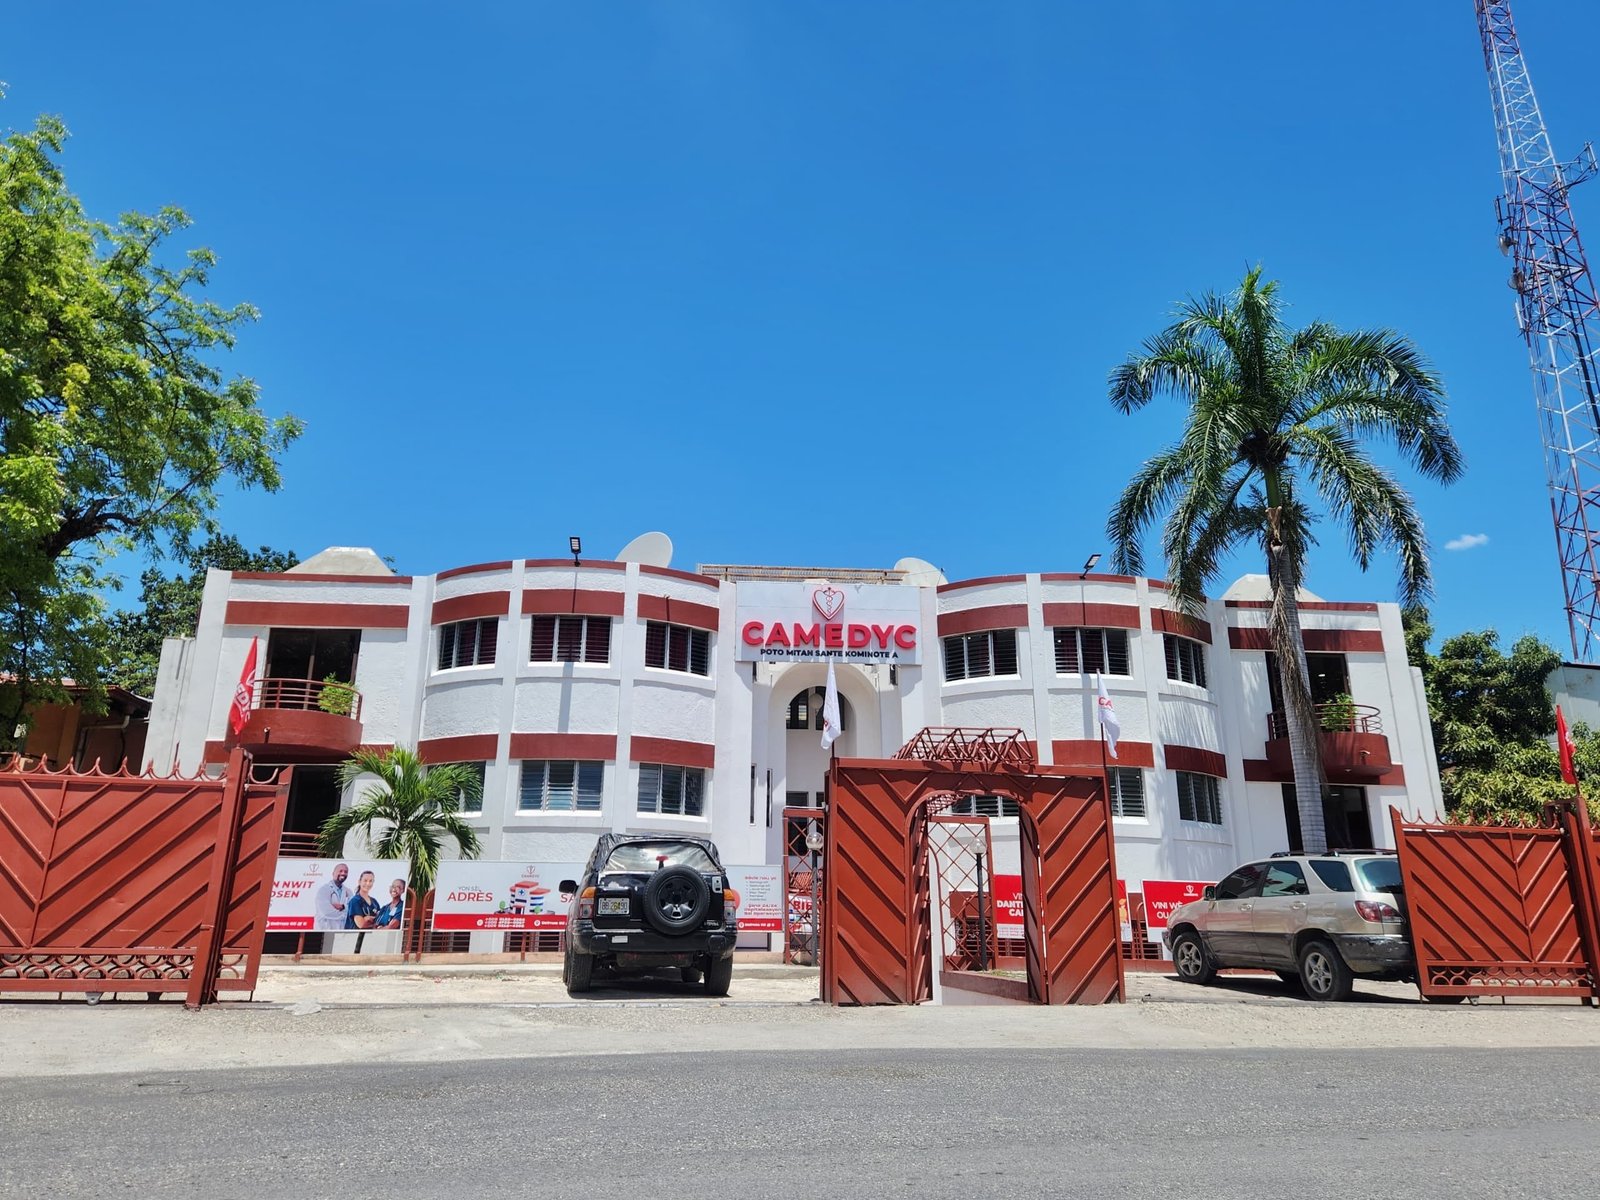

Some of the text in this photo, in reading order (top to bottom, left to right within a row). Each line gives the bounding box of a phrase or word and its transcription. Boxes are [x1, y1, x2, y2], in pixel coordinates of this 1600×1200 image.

[742, 621, 917, 649] CAMEDYC
[760, 648, 784, 656] POTO
[786, 649, 813, 657] MITAN
[815, 650, 844, 658] SANTE
[845, 651, 891, 659] KOMINOTE
[282, 880, 315, 889] NWIT
[447, 889, 494, 902] ADRÈS
[1152, 901, 1168, 909] VINI
